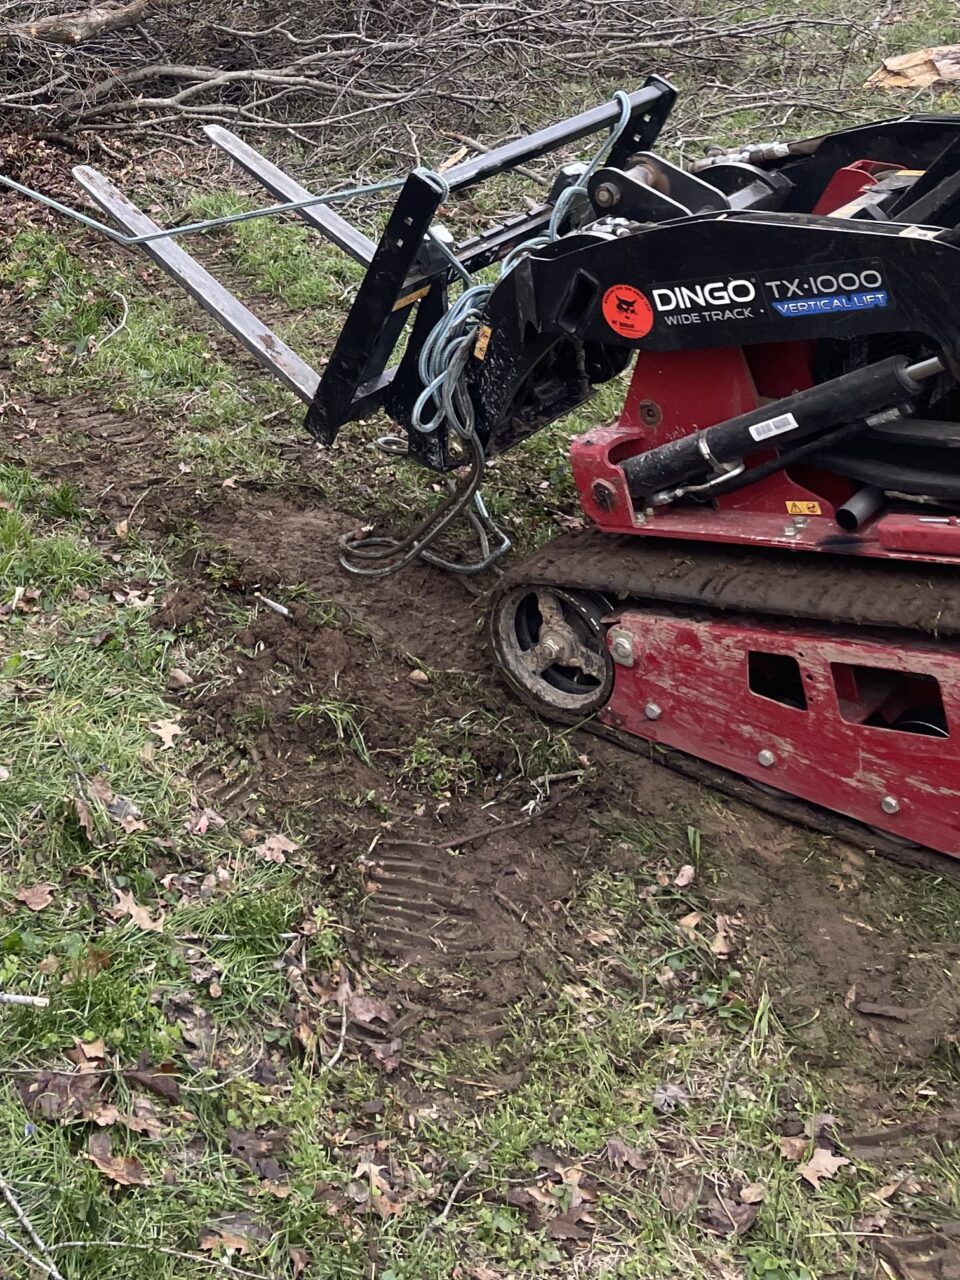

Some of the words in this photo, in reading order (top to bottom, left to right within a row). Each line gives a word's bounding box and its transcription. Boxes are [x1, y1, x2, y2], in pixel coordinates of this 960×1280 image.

[652, 279, 756, 312] DINGO
[777, 298, 852, 313] VERTICAL
[853, 294, 885, 306] LIFT
[664, 312, 701, 326] WIDE
[701, 307, 755, 322] TRACK
